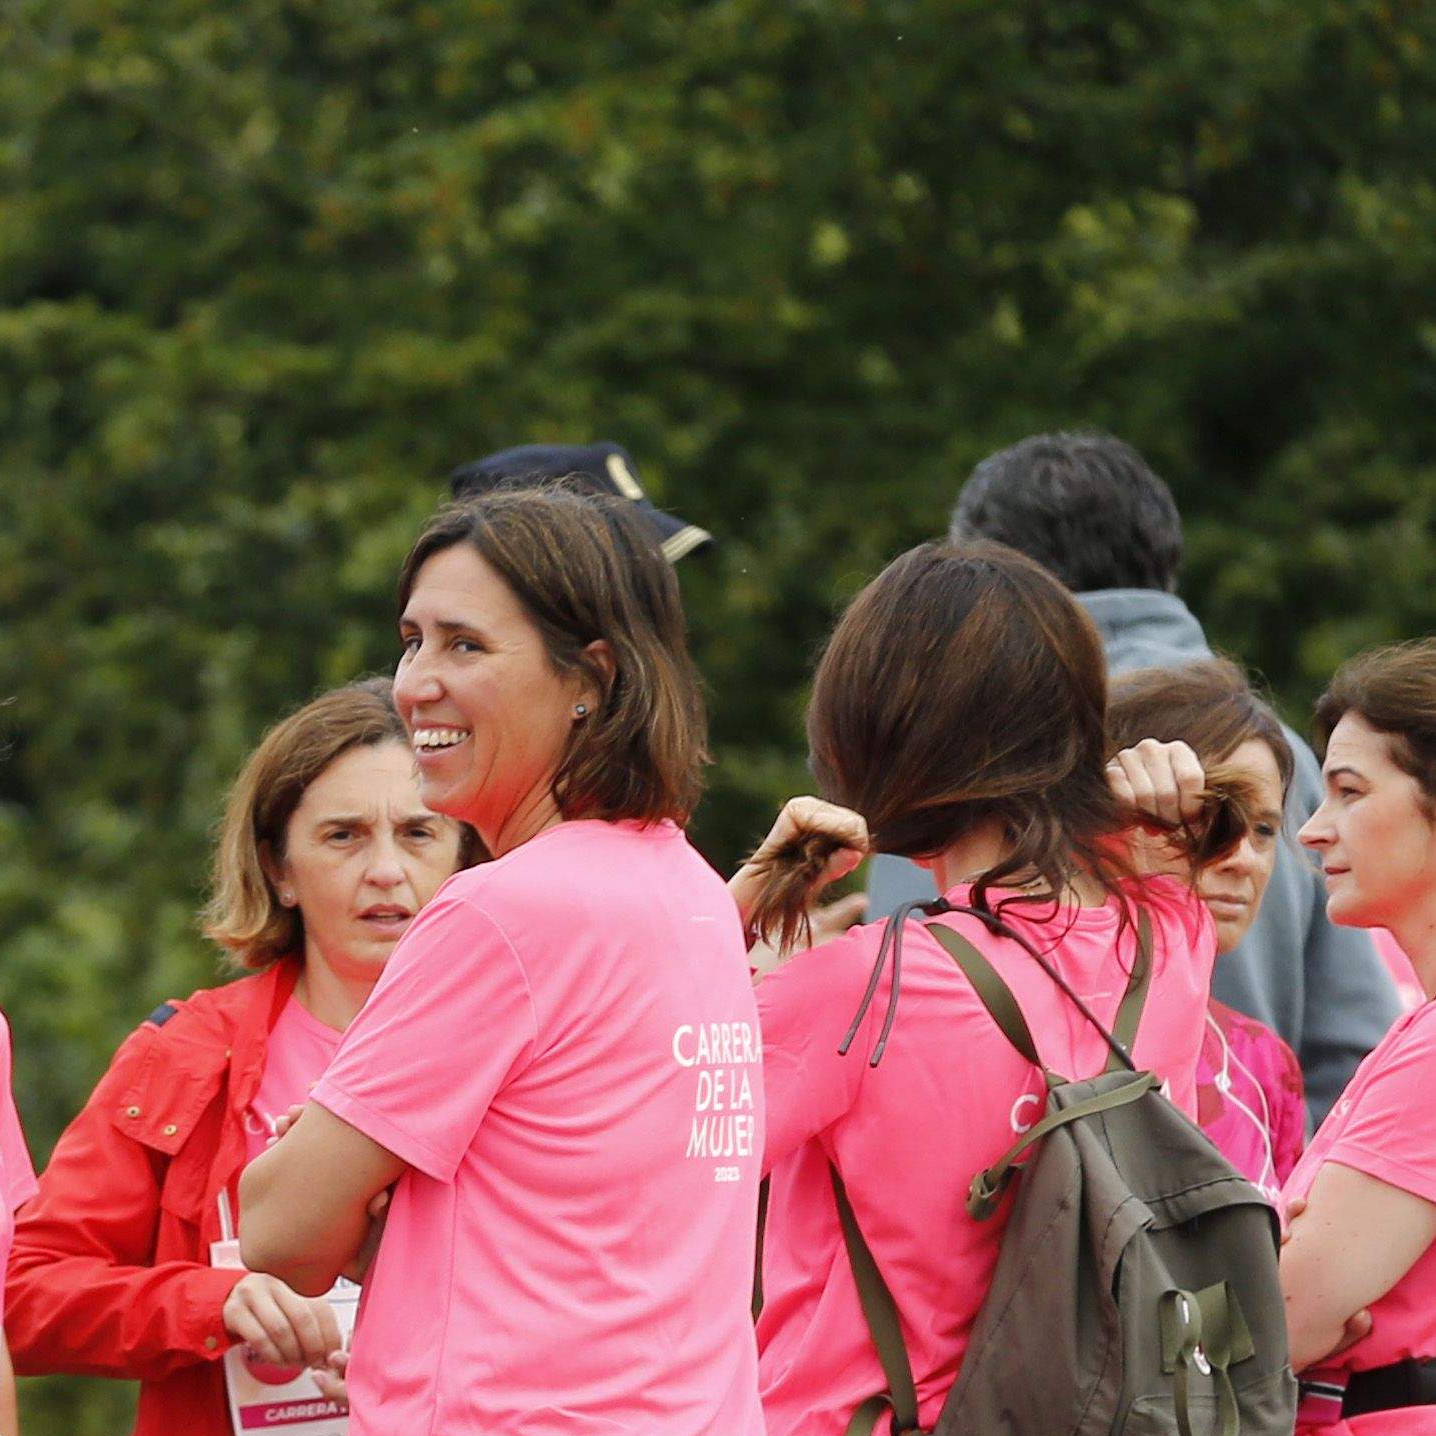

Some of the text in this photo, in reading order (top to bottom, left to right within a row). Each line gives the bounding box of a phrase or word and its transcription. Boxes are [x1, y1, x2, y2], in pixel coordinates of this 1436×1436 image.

[672, 1021, 763, 1067] CARRERA
[695, 1069, 754, 1112] DE LA
[686, 1114, 755, 1158] MUJER
[714, 1166, 741, 1182] 2023
[265, 1402, 338, 1421] CARRERA
